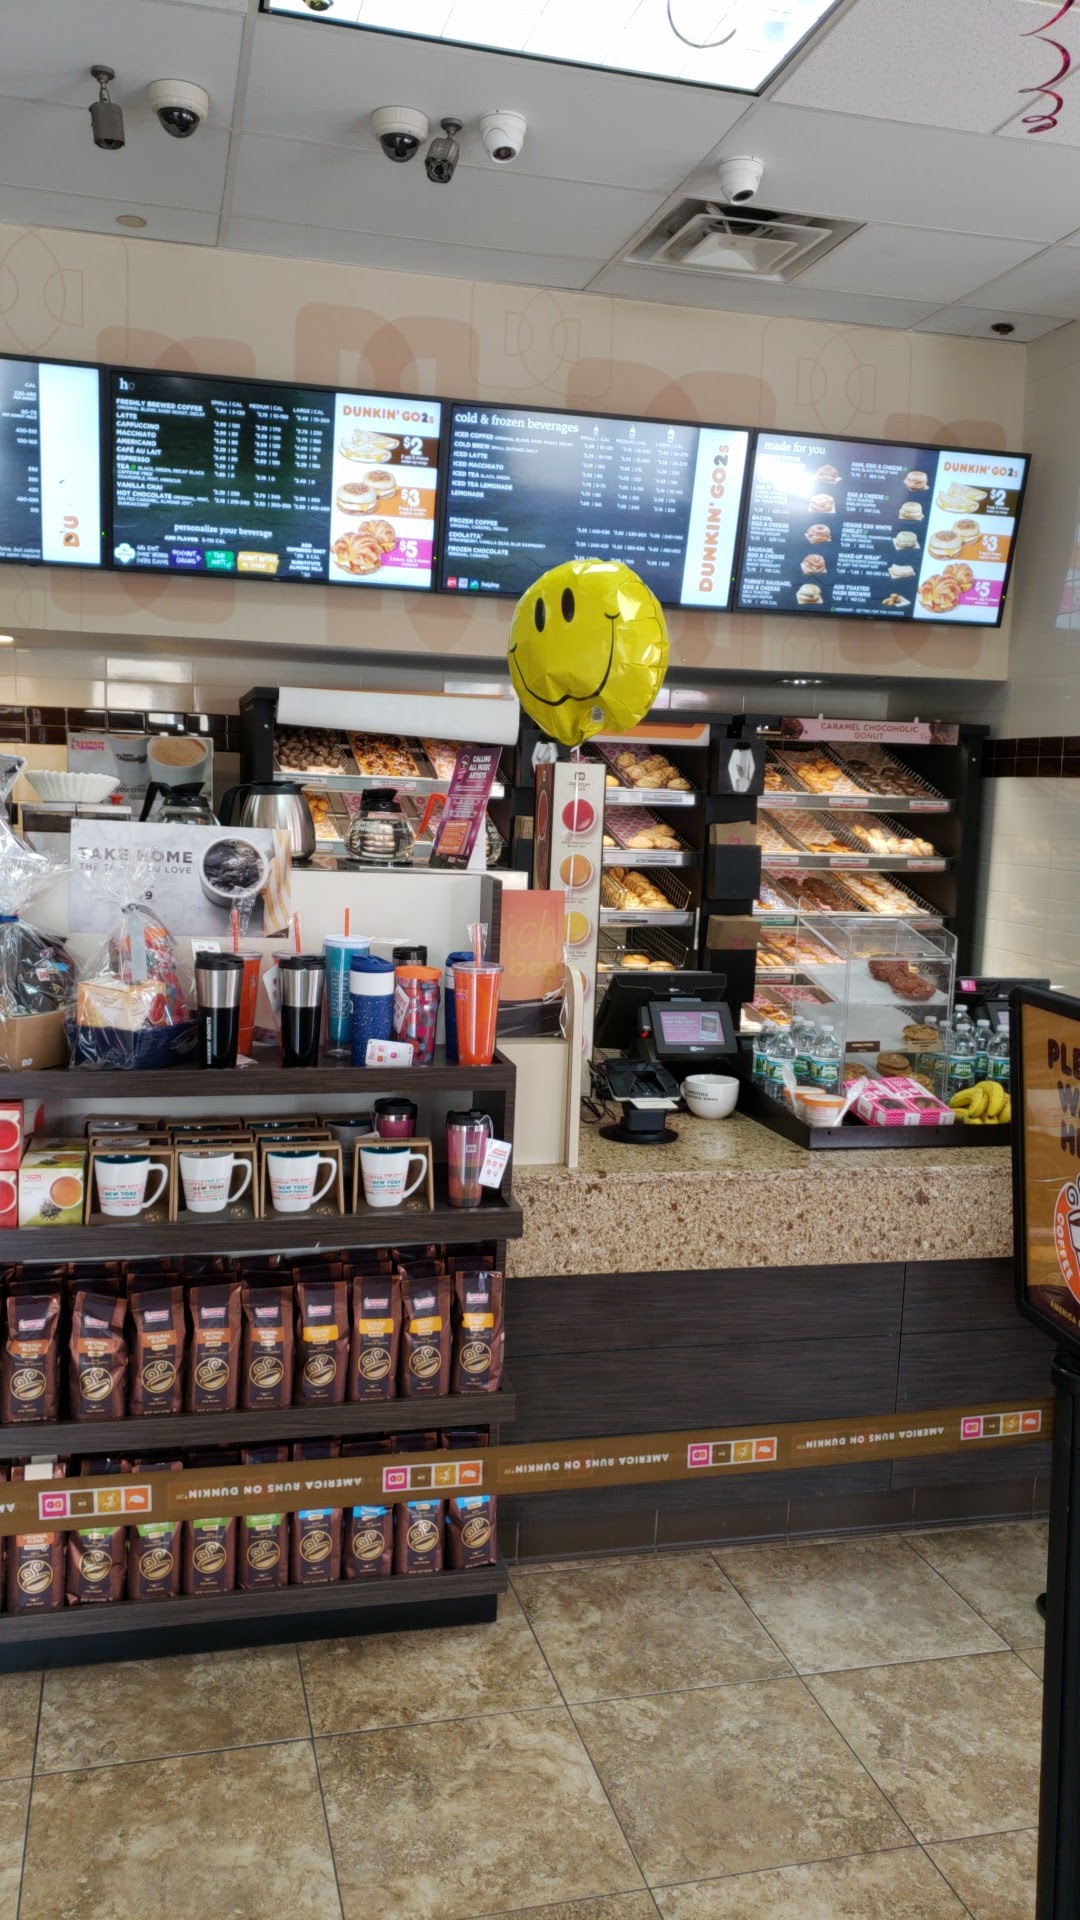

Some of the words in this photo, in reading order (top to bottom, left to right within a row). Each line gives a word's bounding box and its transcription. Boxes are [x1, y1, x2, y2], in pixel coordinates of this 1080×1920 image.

[116, 398, 146, 406] FRESHLY
[147, 400, 176, 409] BREWED
[177, 403, 204, 412] COFFEE
[116, 412, 138, 420] LATTE
[343, 405, 399, 420] DUNKIN'
[116, 420, 160, 430] CAPPUCCINO
[455, 412, 478, 424] cold
[480, 413, 489, 425] &
[491, 414, 525, 428] frozen
[527, 417, 579, 435] beverages
[116, 429, 157, 439] MACCHIATO
[470, 432, 494, 441] COFFEE
[116, 438, 157, 447] AMERICANO
[403, 436, 423, 455] $2
[472, 442, 491, 450] BREW
[764, 440, 791, 450] made
[793, 442, 806, 453] for
[808, 445, 826, 457] you
[116, 455, 151, 463] ESPRESSO
[469, 452, 488, 460] LATTE
[468, 461, 504, 471] MACCHIATO
[943, 462, 991, 474] DUNKIN'
[468, 471, 479, 479] TEA
[116, 482, 145, 490] VANILLA
[480, 482, 513, 491] LEMONADE
[132, 491, 172, 500] CHOCOLATE
[401, 488, 420, 507] $3
[451, 490, 485, 498] LEMONADE
[989, 489, 1007, 506] $2
[449, 517, 473, 525] FROZEN
[474, 518, 498, 527] COFFEE
[174, 523, 218, 534] personalize
[219, 526, 238, 535] your
[238, 527, 273, 538] beverage
[699, 502, 722, 593] DUNKIN'
[982, 535, 998, 552] $3
[399, 539, 418, 559] $5
[448, 546, 472, 554] FROZEN
[473, 547, 509, 556] CHOCOLATE
[846, 584, 870, 592] TOASTED
[974, 581, 991, 598] $5
[821, 722, 860, 731] CARAMEL
[863, 724, 919, 733] CHOCOHOLIC
[854, 732, 884, 740] DONUT
[472, 755, 492, 763] CALLING
[79, 863, 99, 871] THE
[165, 866, 192, 875] LOVE
[145, 891, 153, 900] 9
[1057, 1212, 1073, 1280] COFFEE
[1050, 1300, 1077, 1323] AMERICA
[868, 1432, 895, 1442] RUNS
[899, 1426, 944, 1438] AMERICA
[850, 1435, 865, 1444] ON
[585, 1457, 614, 1468] RUNS
[619, 1453, 669, 1465] AMERICA
[564, 1460, 581, 1469] ON
[267, 1482, 300, 1493] RUNS
[304, 1477, 362, 1490] AMERICA
[243, 1485, 262, 1494] ON
